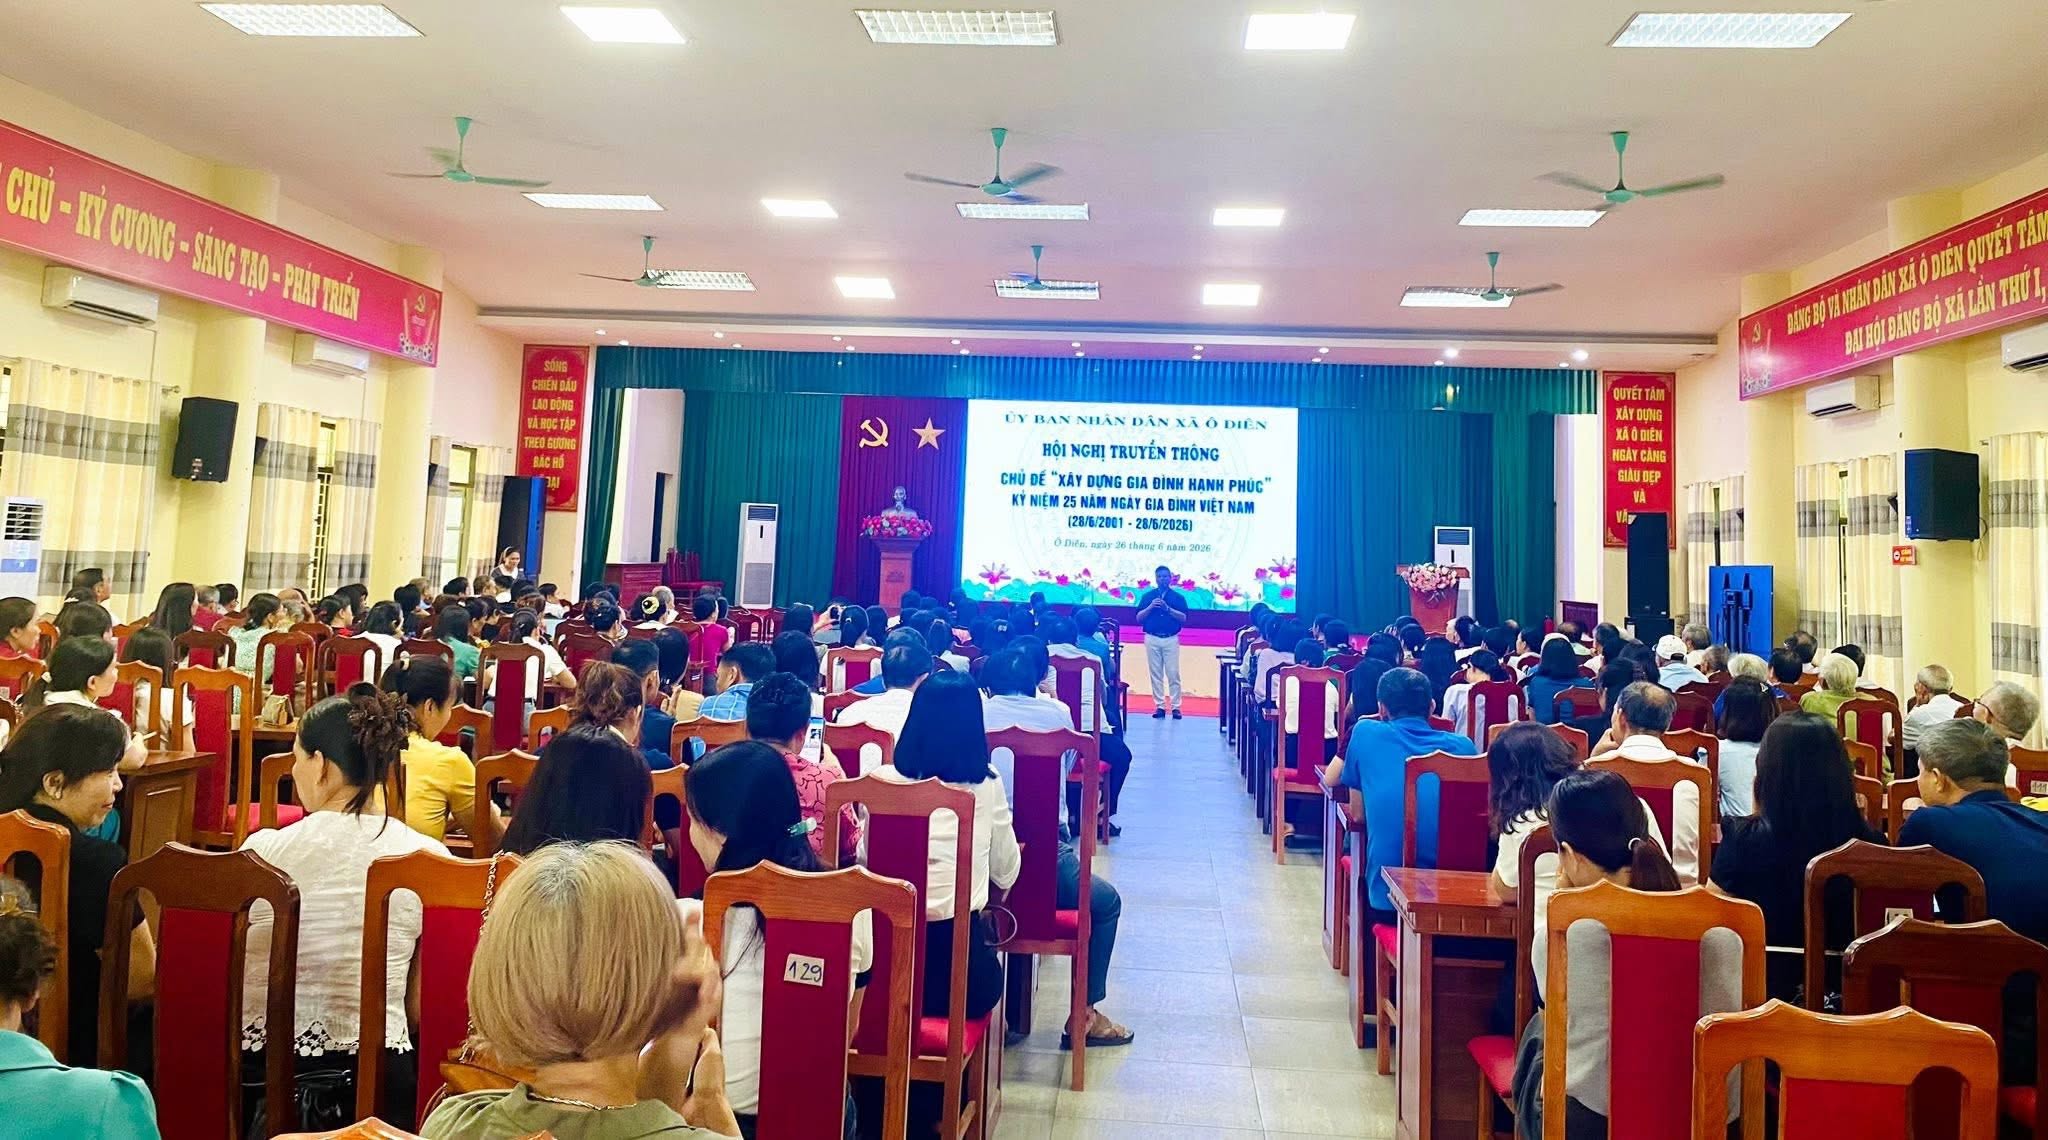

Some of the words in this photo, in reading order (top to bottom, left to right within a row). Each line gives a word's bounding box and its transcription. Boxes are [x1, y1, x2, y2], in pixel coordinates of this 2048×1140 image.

[6, 166, 55, 224] CHỦ
[75, 185, 107, 241] KỶ
[110, 203, 177, 263] CƯƠNG
[192, 226, 236, 282] SÁNG
[240, 247, 269, 297] TẠO
[283, 262, 320, 309] PHÁT
[322, 271, 360, 322] TRIỂN
[1787, 304, 1811, 335] ĐẢNG
[1812, 294, 1826, 329] BỘ
[1828, 288, 1840, 320] VÀ
[1842, 278, 1871, 315] NHÂN
[1872, 268, 1896, 303] DÂN
[1919, 252, 1928, 286] Ô
[1931, 241, 1963, 281] DIÊN
[1967, 217, 2013, 275] QUYẾT
[2016, 208, 2048, 250] TÂM
[1845, 326, 1864, 359] ĐẠI
[1865, 315, 1886, 352] HỘI
[1888, 305, 1920, 342] ĐẢNG
[1923, 294, 1941, 334] BỘ
[1968, 274, 1996, 318] LẦN
[1999, 264, 2031, 308] THỨ
[543, 356, 568, 372] SỐNG
[532, 375, 558, 392] CHIẾN
[1613, 384, 1643, 401] QUYẾT
[1644, 386, 1665, 402] TÂM
[532, 398, 549, 411] LAO
[550, 396, 574, 414] ĐỘNG
[1035, 415, 1070, 425] BAN
[1076, 413, 1126, 426] NHÂN
[1132, 415, 1169, 427] DÂN
[1175, 416, 1199, 428] XÃ
[1205, 416, 1218, 429] Ô
[1224, 417, 1267, 430] DIÊN
[1616, 405, 1634, 422] XÂY
[1636, 408, 1663, 425] DỰNG
[527, 415, 540, 430] VÀ
[540, 418, 558, 433] HỌC
[559, 416, 576, 433] TẬP
[524, 436, 546, 449] THEO
[1616, 427, 1629, 442] XÃ
[1631, 427, 1638, 442] Ô
[1640, 427, 1663, 443] DIÊN
[1042, 439, 1066, 461] HỘI
[1070, 443, 1106, 462] NGHỊ
[1171, 443, 1220, 462] THÔNG
[1612, 447, 1638, 462] NGÀY
[1640, 447, 1667, 463] CÀNG
[533, 453, 551, 469] BÁC
[1000, 468, 1026, 486] CHỦ
[1087, 474, 1122, 491] DỰNG
[1126, 476, 1148, 489] GIA
[1152, 474, 1184, 491] ĐÌNH
[1188, 478, 1224, 494] HẠNH
[1618, 467, 1640, 483] GIÀU
[1011, 489, 1026, 507] KỶ
[1030, 492, 1059, 510] NIỆM
[1063, 496, 1077, 508] 25
[1080, 493, 1107, 509] NĂM
[1111, 494, 1141, 511] NGÀY
[1145, 498, 1164, 511] GIA
[1168, 496, 1196, 512] ĐÌNH
[1200, 497, 1224, 516] VIỆT
[1228, 501, 1255, 514] NAM
[1633, 487, 1647, 504] VÀ
[1068, 515, 1123, 529] (28/6/2001
[1135, 517, 1193, 532] 28/6/2026)
[1616, 508, 1628, 524] VĂ
[1054, 536, 1062, 547] Ô
[1091, 540, 1113, 550] ngày
[1115, 541, 1127, 549] 26
[1158, 542, 1164, 550] 6
[1166, 542, 1186, 551] năm
[1189, 543, 1211, 552] 2026
[788, 960, 822, 982] 129
